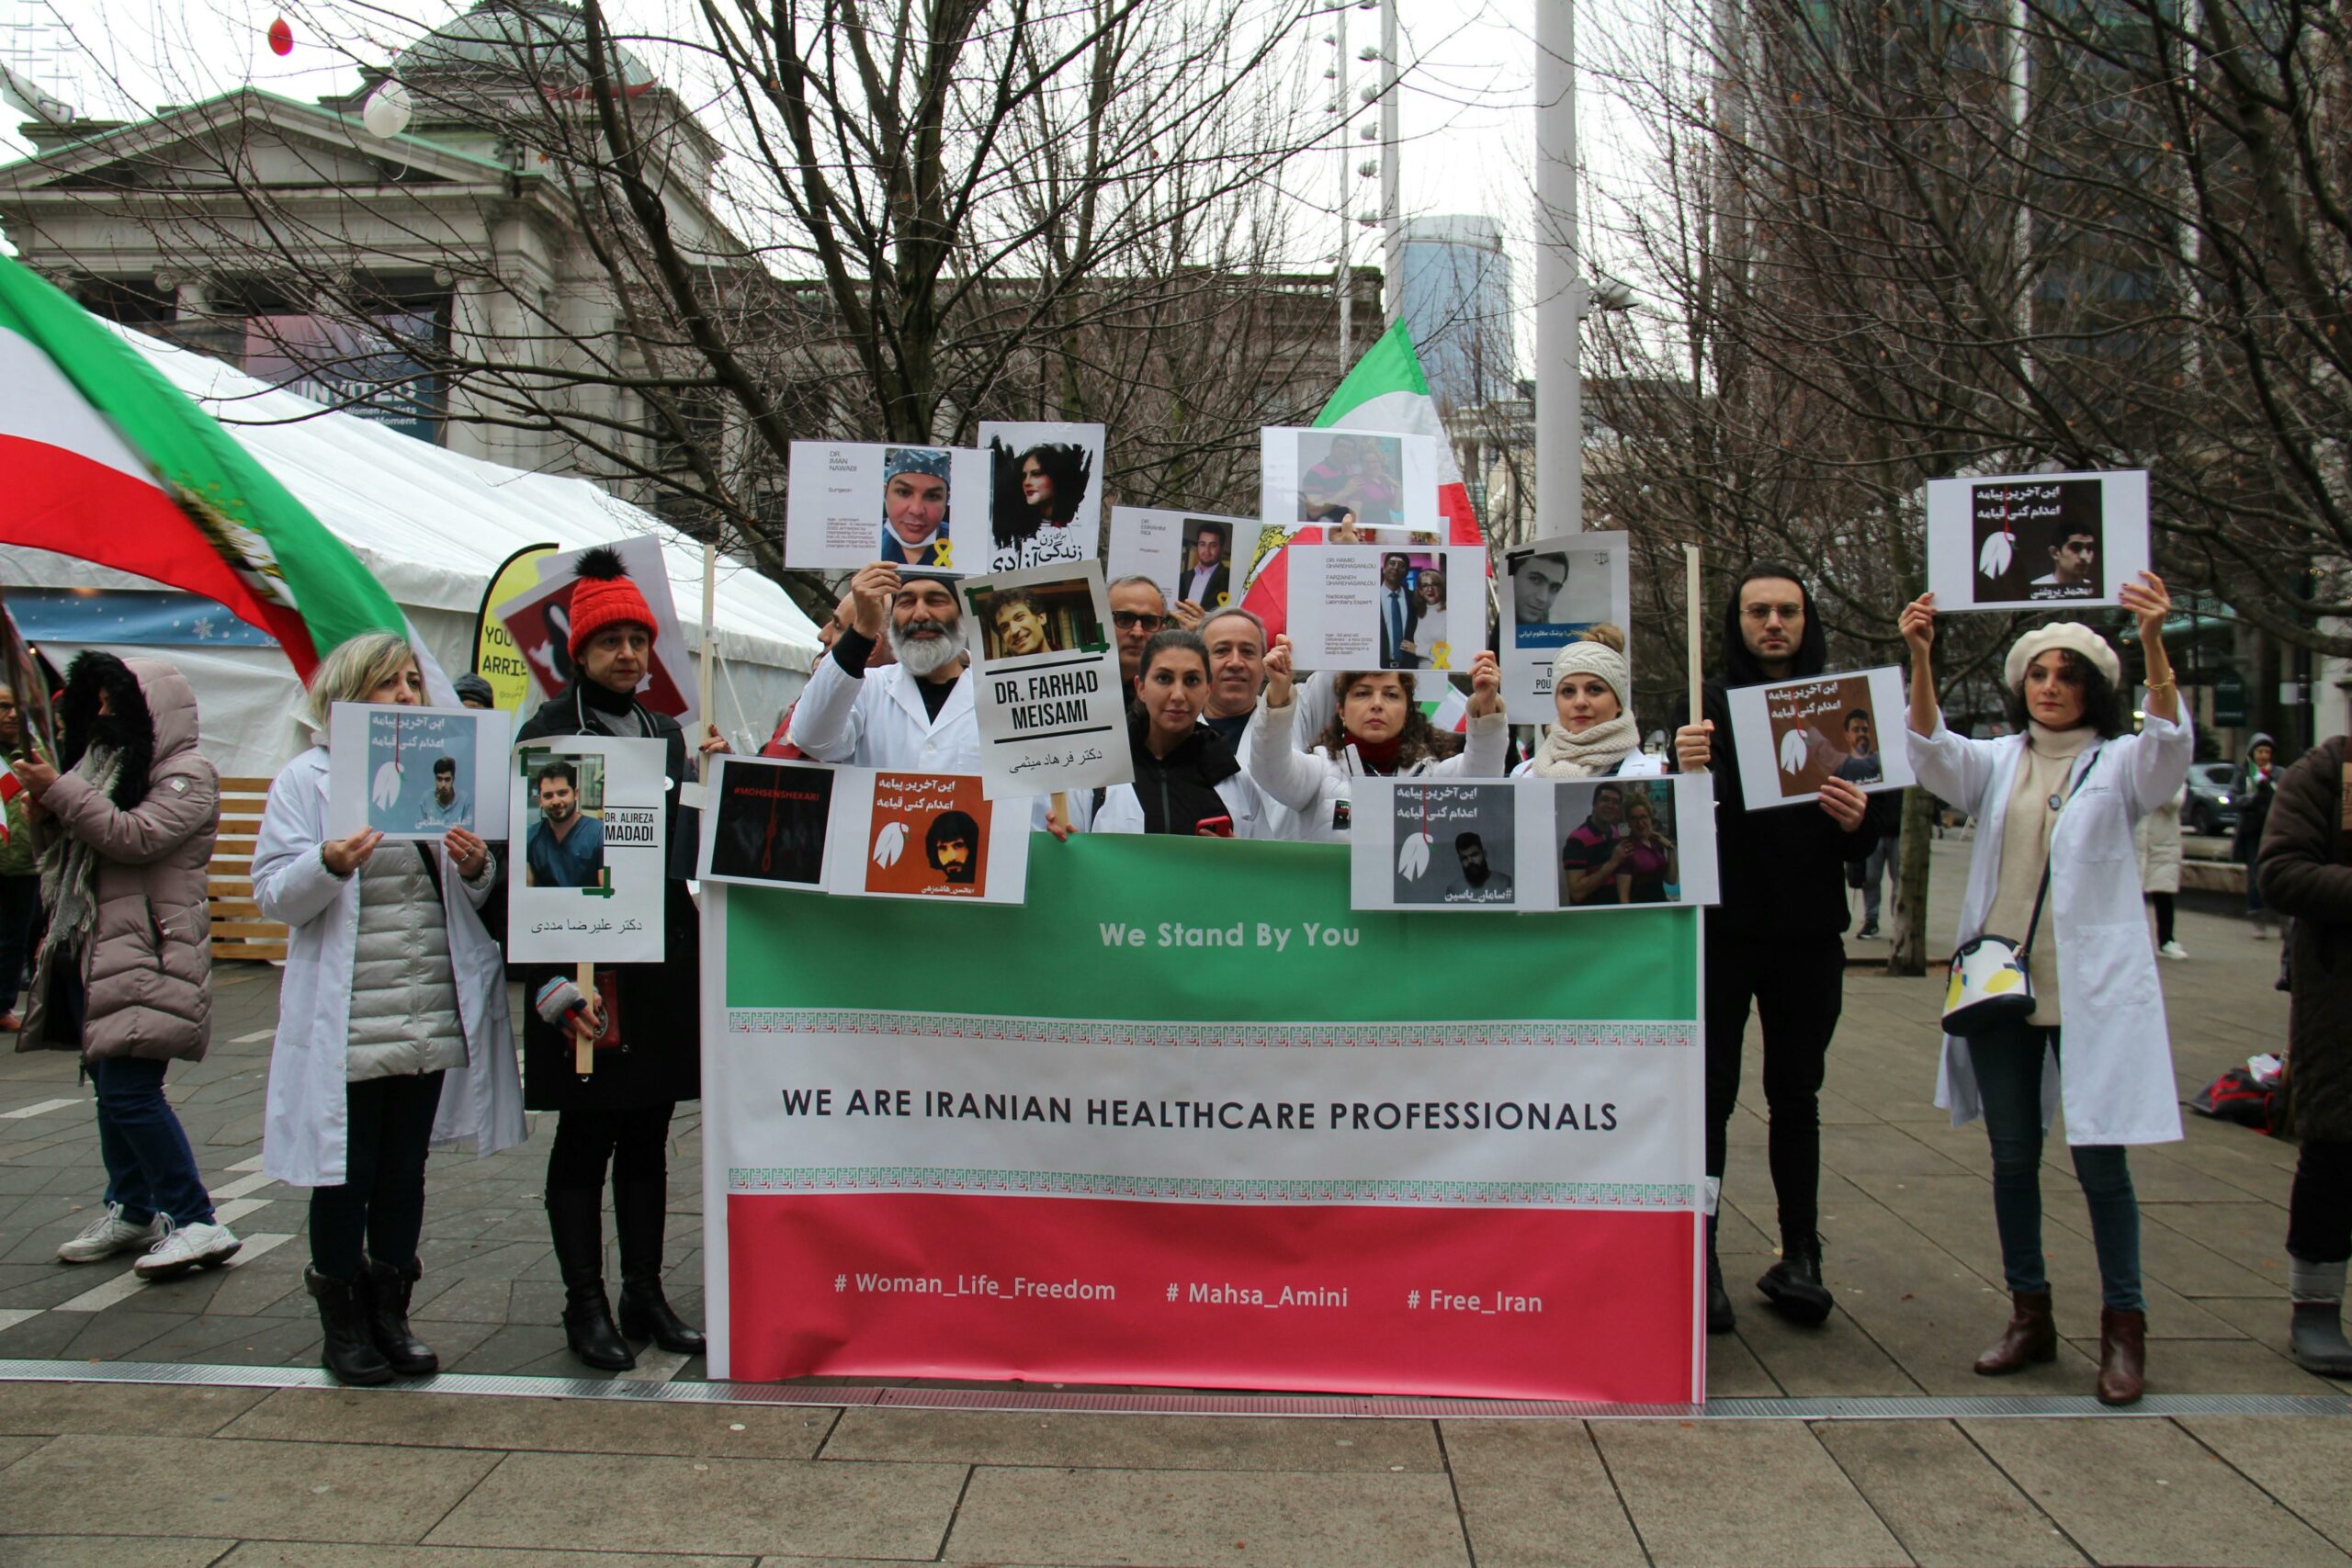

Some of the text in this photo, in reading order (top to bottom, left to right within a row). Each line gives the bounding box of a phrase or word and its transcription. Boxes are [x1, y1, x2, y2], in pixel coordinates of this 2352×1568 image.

[2041, 486, 2061, 499] این
[2007, 505, 2030, 521] کنی
[2030, 505, 2061, 519] اعدام
[1039, 534, 1054, 547] زن
[1039, 541, 1082, 562] زندگی
[995, 670, 1099, 705] DR. FARHAD
[1823, 682, 1838, 695] این
[1012, 698, 1089, 730] MEISAMI
[1817, 700, 1842, 716] اعدام
[429, 718, 445, 730] این
[418, 738, 445, 751] اعدام
[1009, 755, 1042, 773] میثمی
[1079, 748, 1102, 765] دکتر
[878, 778, 956, 793] این آخرین پیامه
[1459, 787, 1477, 800] این
[733, 786, 820, 802] #MOHSENSHEKARI
[876, 796, 954, 812] اعدام کنی قیامه
[605, 812, 654, 824] DR. ALIREZA
[1426, 806, 1448, 821] کنی
[1449, 807, 1477, 821] اعدام
[605, 825, 653, 841] MADADI
[531, 919, 642, 934] دکتر علیرضا مددی
[1099, 922, 1360, 953] We Stand By You
[782, 1089, 1618, 1131] WE ARE IRANIAN HEALTHCARE PROFESSIONALS
[834, 1273, 1116, 1301] # Woman_Life_Freedom
[1166, 1282, 1349, 1309] # Mahsa_Amini
[1407, 1289, 1543, 1314] # Free_Iran
